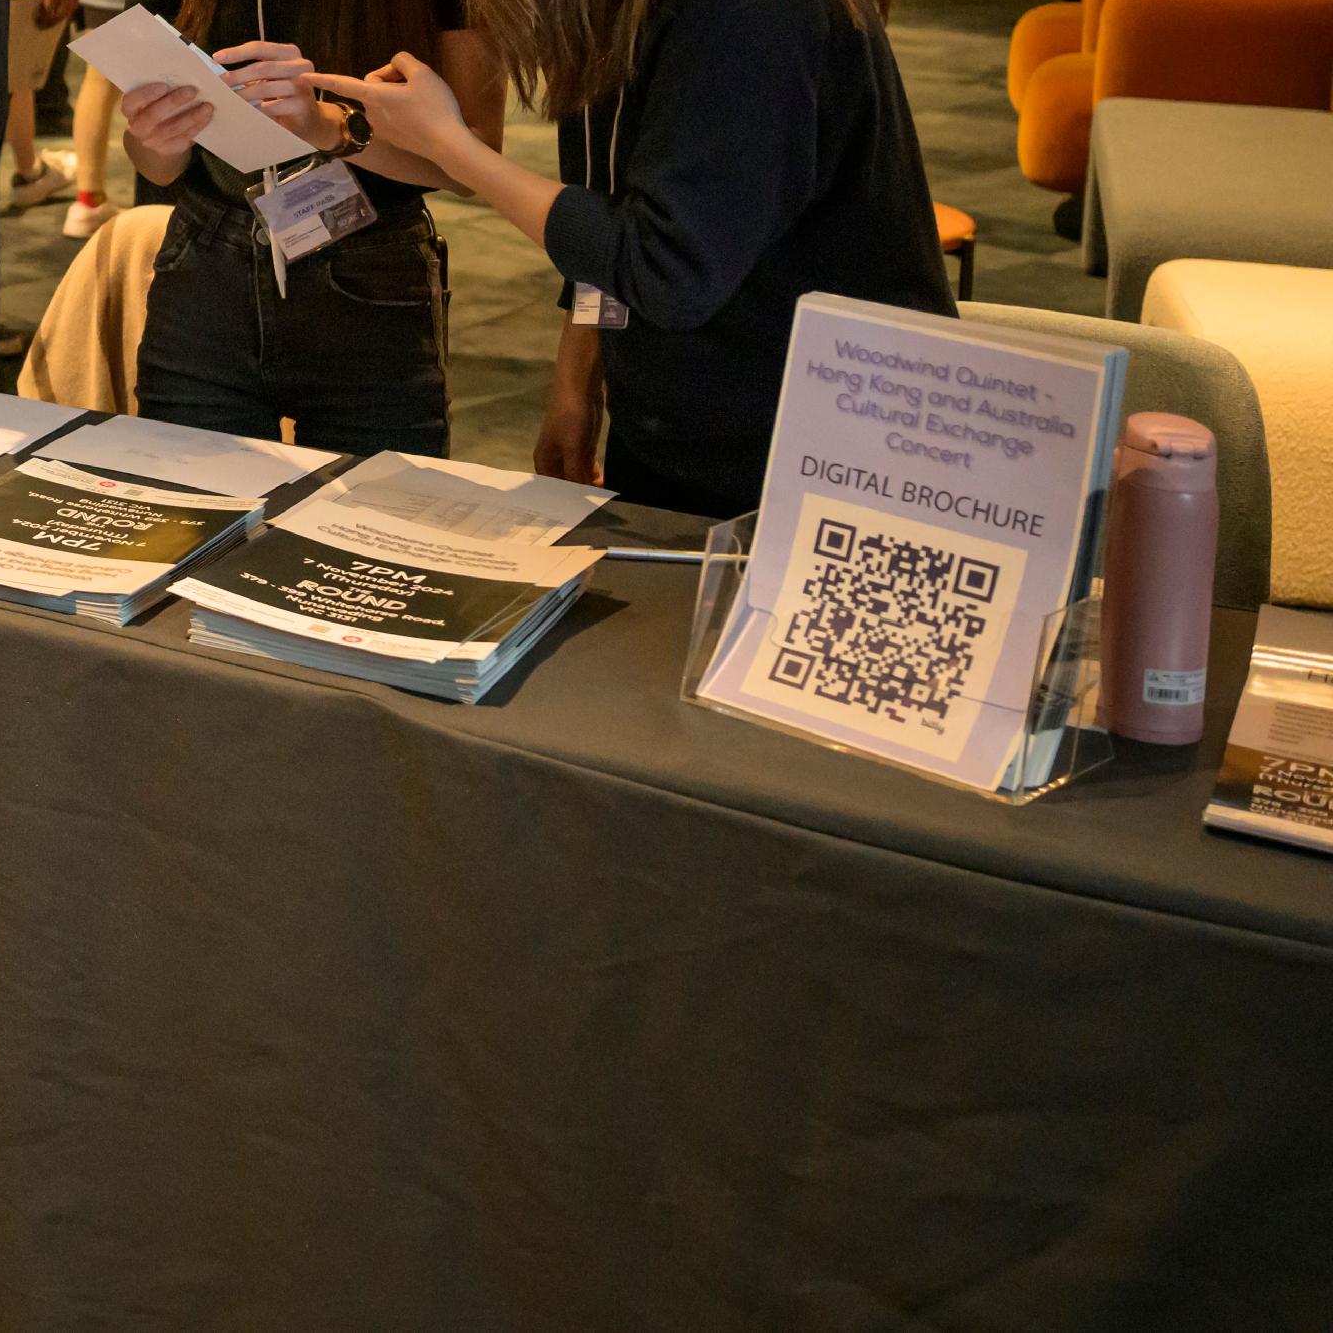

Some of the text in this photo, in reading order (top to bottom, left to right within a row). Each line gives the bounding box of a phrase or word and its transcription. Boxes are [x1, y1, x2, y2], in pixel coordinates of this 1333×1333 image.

[834, 338, 950, 381] Woodwind
[955, 366, 1038, 402] Quintet
[806, 359, 1076, 439] Hong Kong and Australia
[835, 392, 1035, 460] Cultural Exchange
[885, 431, 974, 469] Concert
[28, 490, 64, 504] Road,
[78, 497, 164, 518] Nunawading
[132, 502, 152, 511] VIC
[800, 454, 1046, 537] DIGITAL BROCHURE
[12, 518, 51, 530] 2024
[45, 519, 129, 539] (Thursday)
[56, 507, 155, 531] ROUND
[32, 531, 102, 551] 7PM
[54, 525, 133, 546] November
[302, 557, 454, 596] 7 November 2024
[323, 571, 416, 598] (Thursday)
[350, 560, 428, 585] 7PM
[285, 594, 384, 622] Nunawading
[296, 579, 408, 611] ROUND
[299, 604, 326, 615] VIC
[311, 593, 399, 618] Whitehorse
[401, 613, 446, 627] Road,
